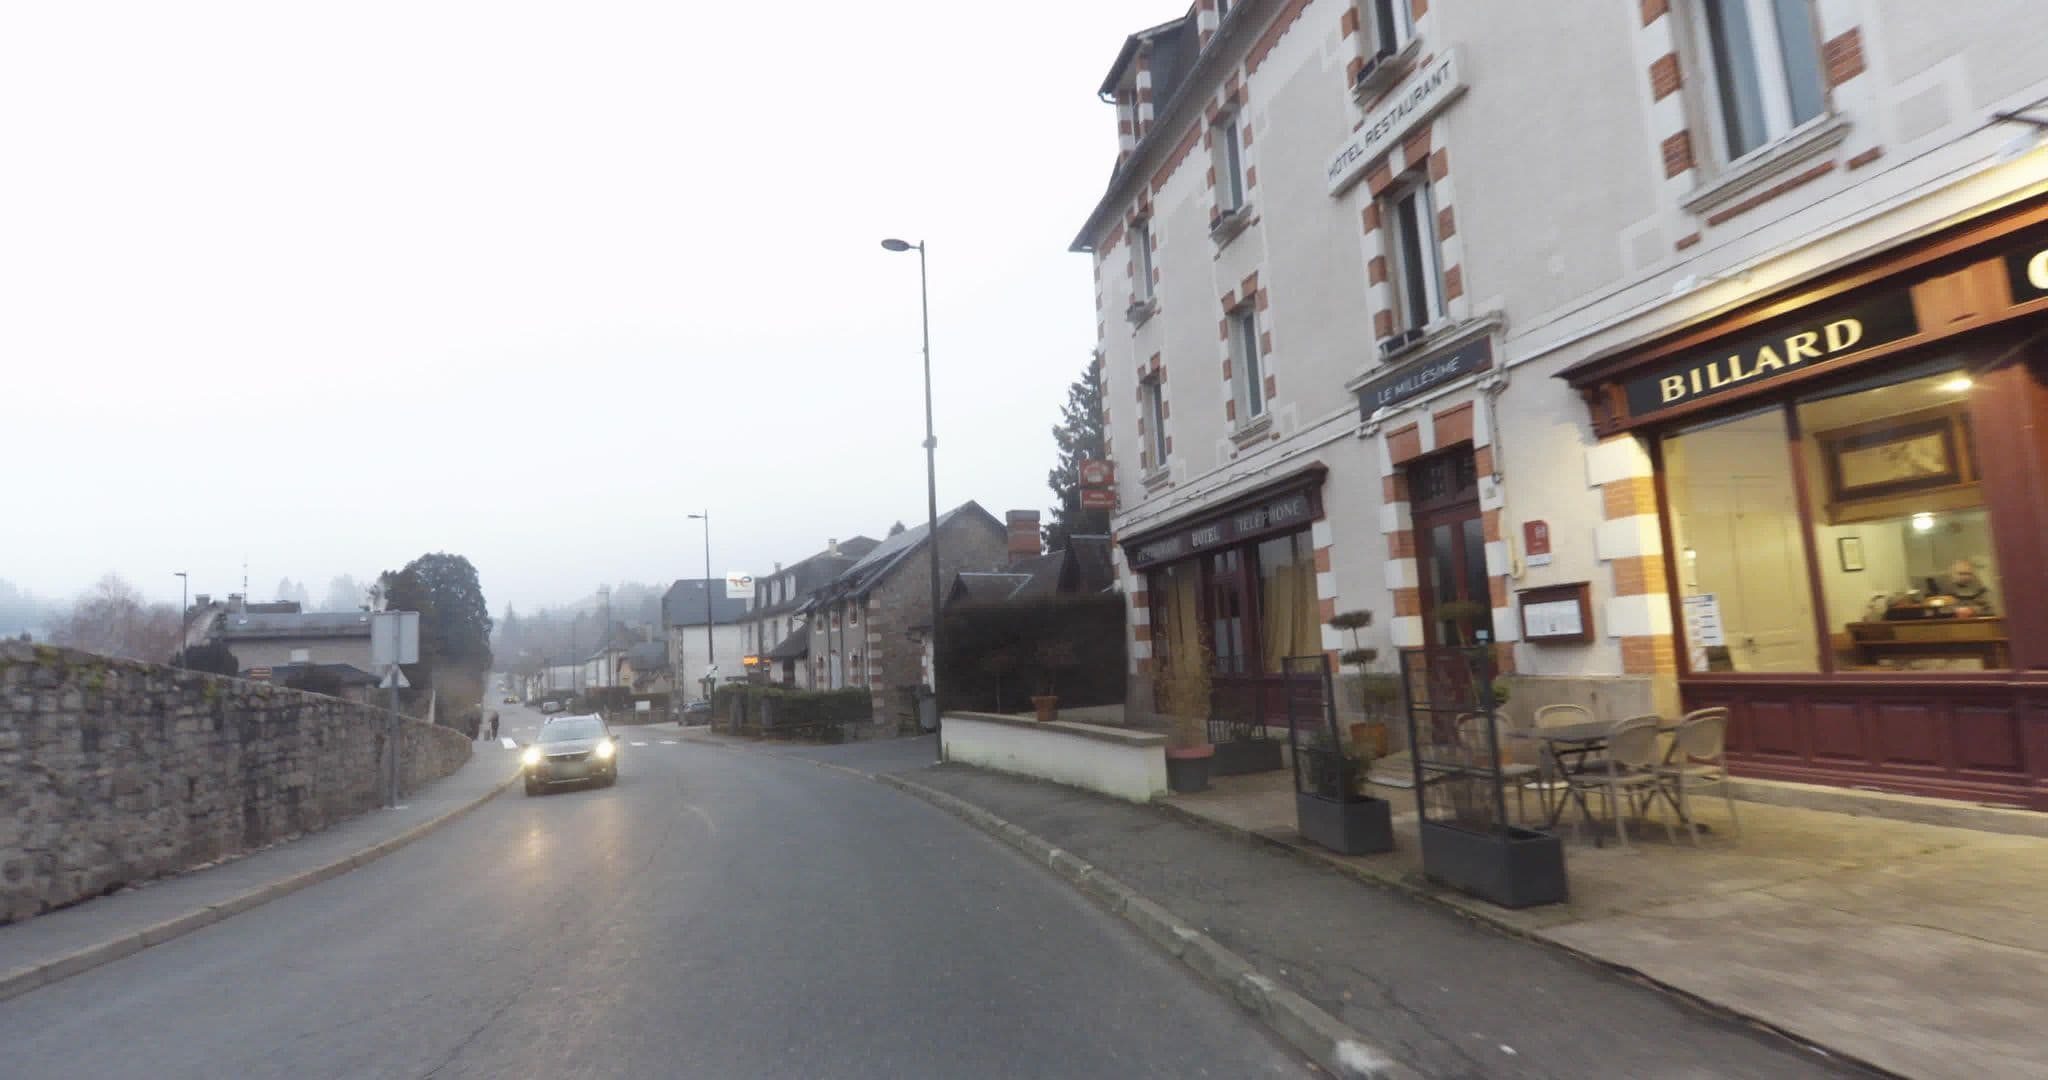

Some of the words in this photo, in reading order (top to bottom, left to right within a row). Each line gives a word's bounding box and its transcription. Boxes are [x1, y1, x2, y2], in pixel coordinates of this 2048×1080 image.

[1365, 60, 1450, 148] RESTAURANT
[1376, 386, 1393, 404] LE
[1659, 318, 1863, 403] BILLARD
